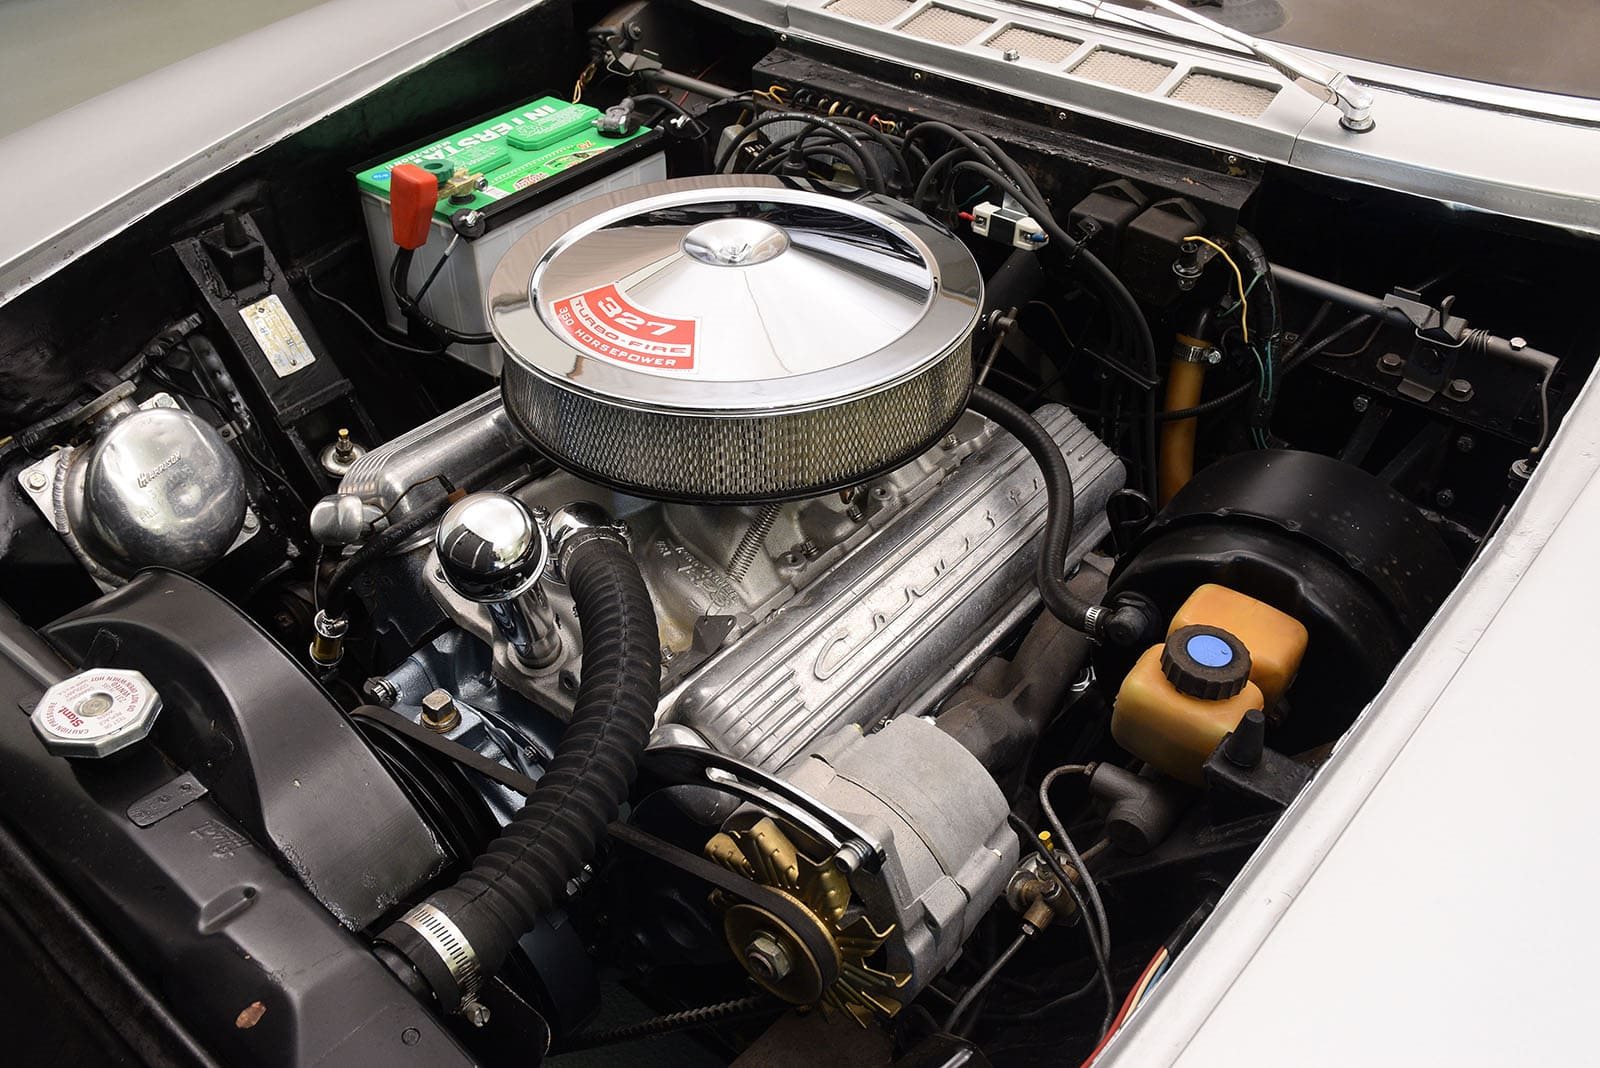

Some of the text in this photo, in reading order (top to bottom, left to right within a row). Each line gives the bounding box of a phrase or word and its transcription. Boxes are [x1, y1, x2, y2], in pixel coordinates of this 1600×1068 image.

[559, 305, 677, 367] 350 HORSEPOWER
[597, 296, 677, 336] 327
